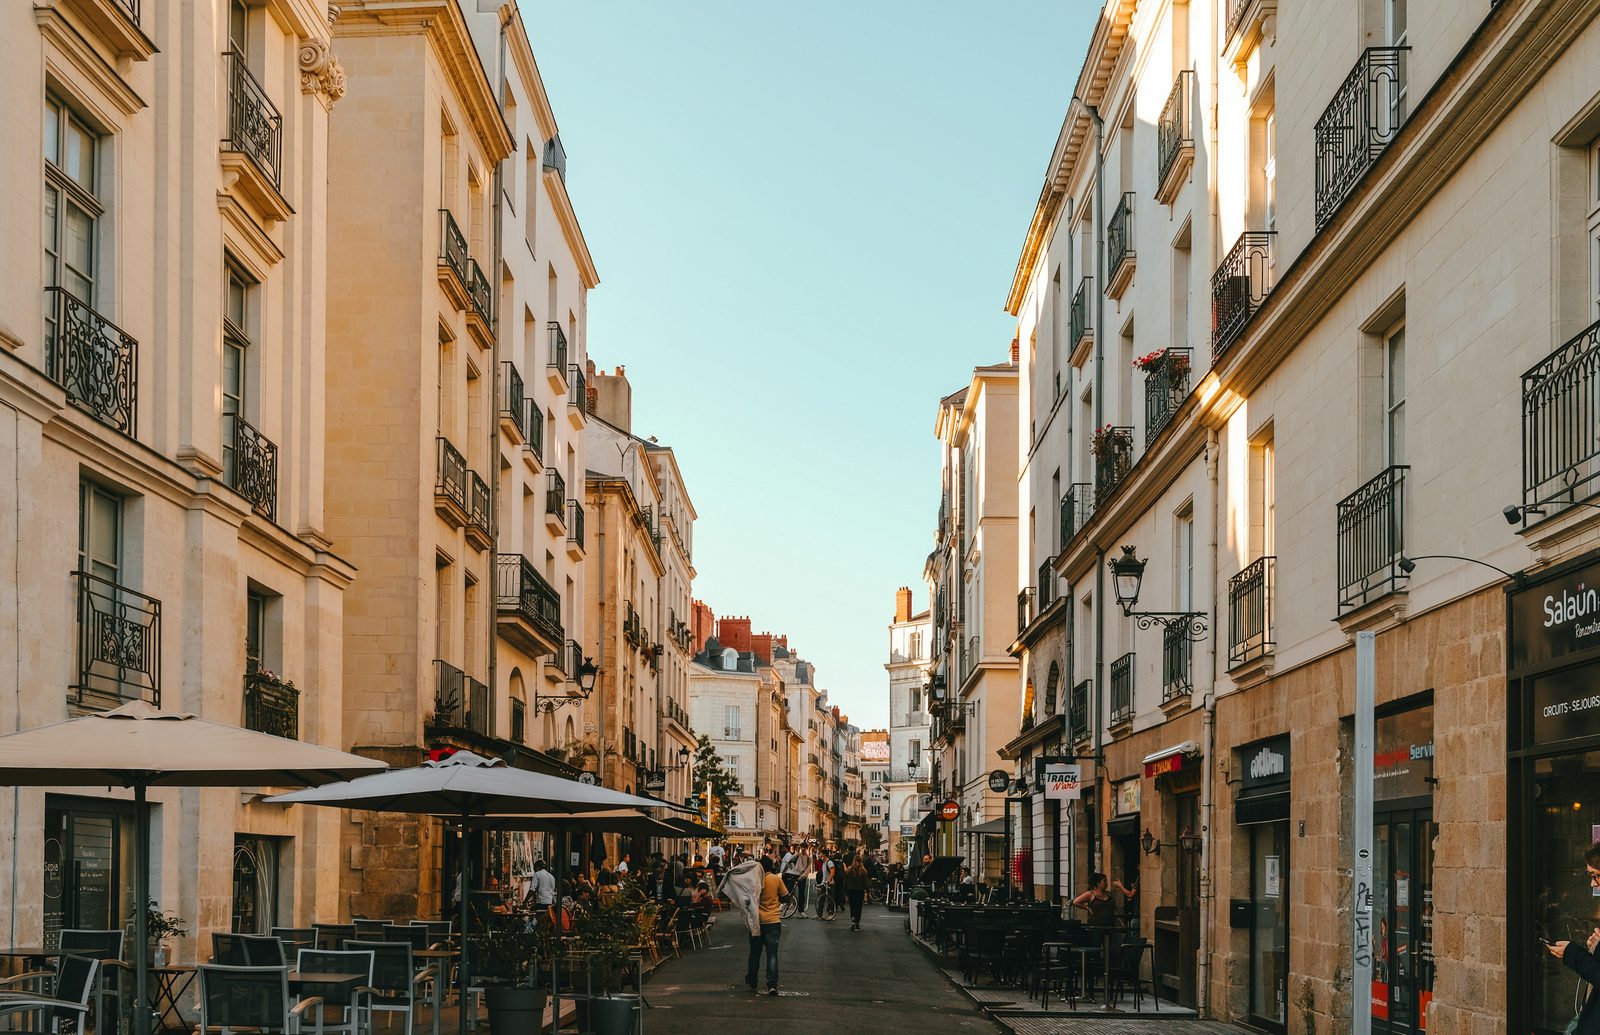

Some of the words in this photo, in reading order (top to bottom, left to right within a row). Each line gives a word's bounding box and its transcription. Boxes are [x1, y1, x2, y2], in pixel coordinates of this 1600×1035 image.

[1543, 582, 1597, 627] Salaün
[1543, 702, 1568, 717] CIRCUITS
[1047, 772, 1078, 783] TRACK
